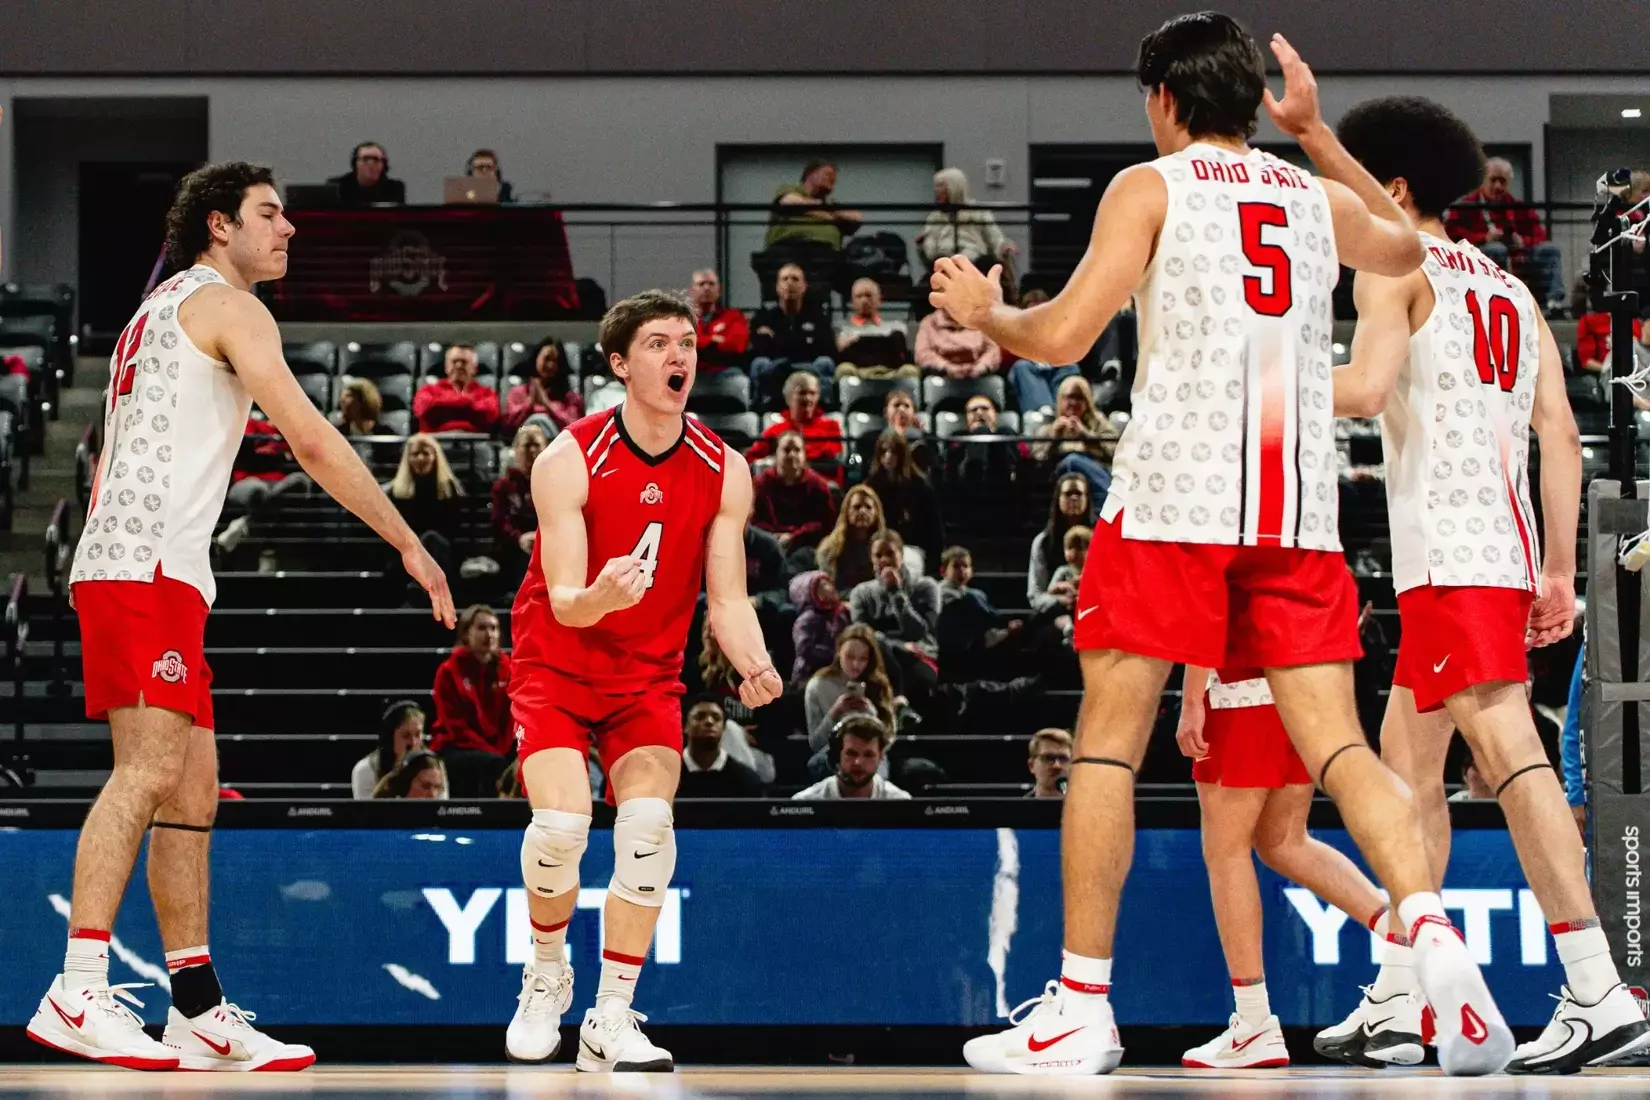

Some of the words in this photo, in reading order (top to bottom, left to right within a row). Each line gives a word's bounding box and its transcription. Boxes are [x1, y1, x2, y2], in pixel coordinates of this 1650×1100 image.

[1191, 159, 1250, 184] OHIO
[1237, 201, 1293, 318] 5
[111, 310, 150, 414] 12
[1465, 287, 1521, 393] 10
[628, 520, 664, 590] 4
[1621, 825, 1642, 888] sports
[1623, 890, 1644, 968] imports
